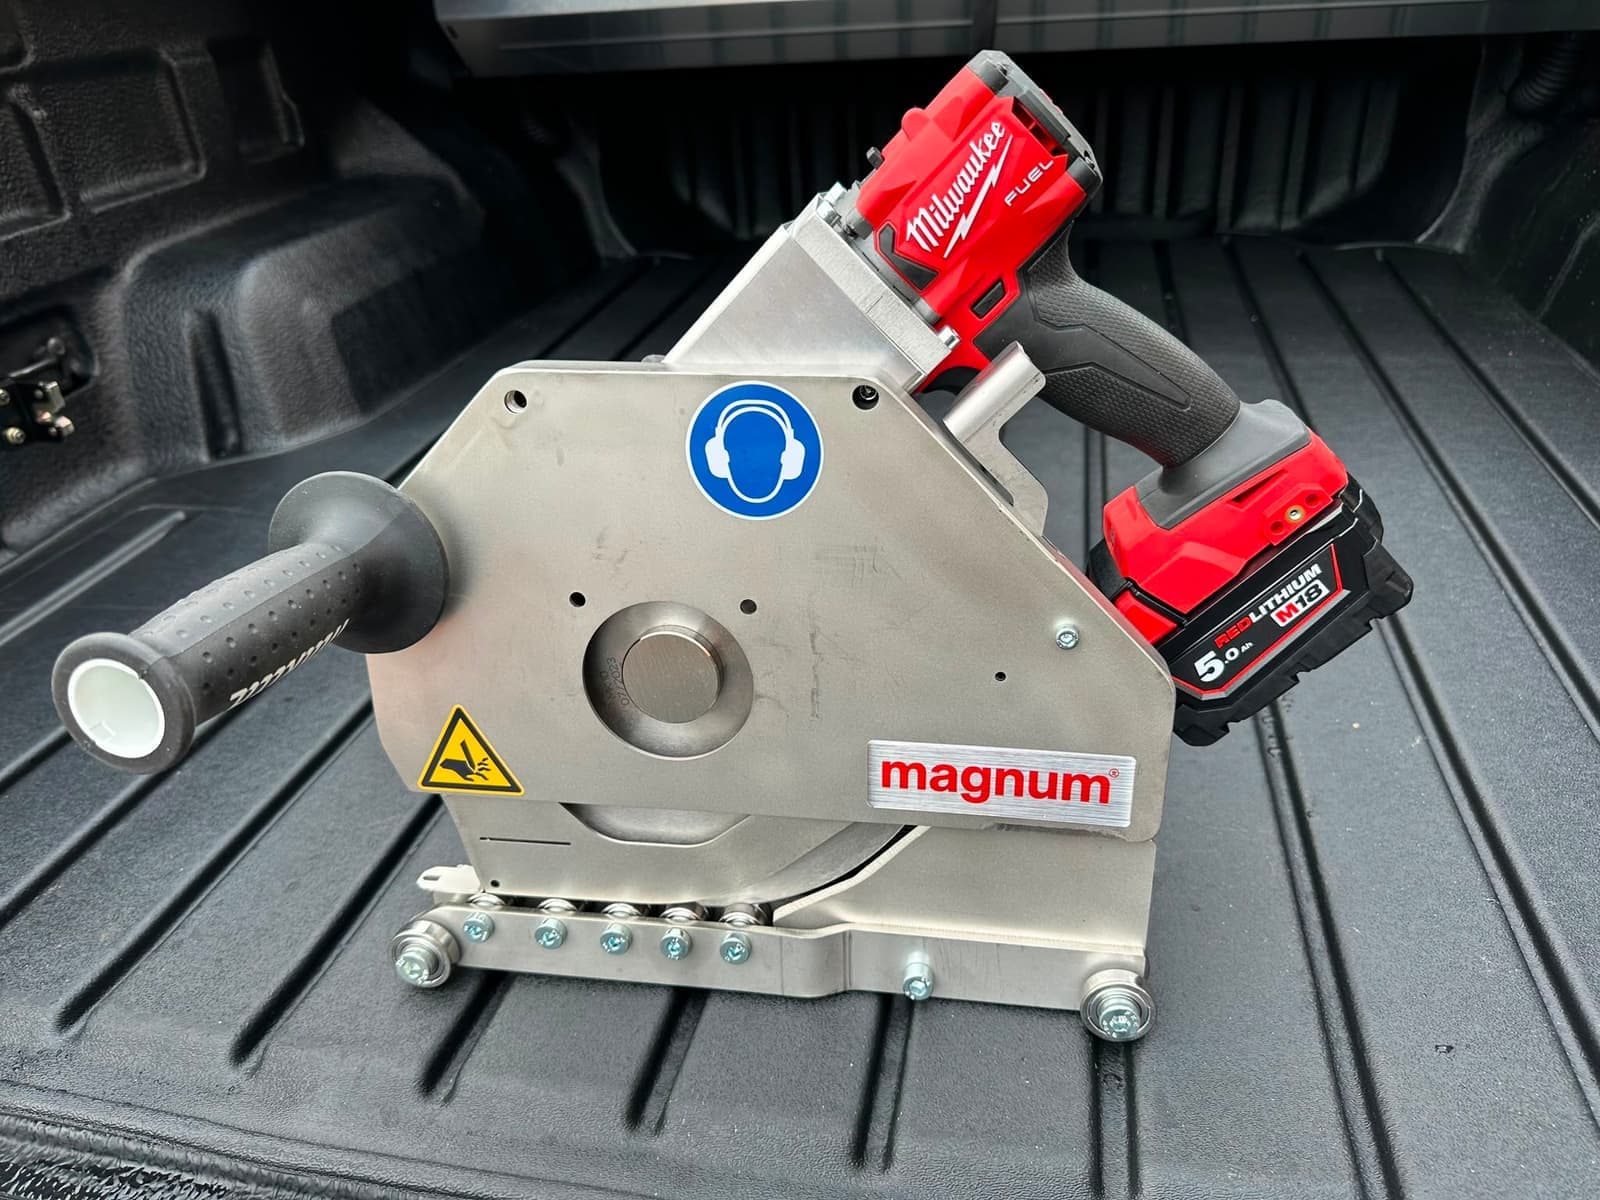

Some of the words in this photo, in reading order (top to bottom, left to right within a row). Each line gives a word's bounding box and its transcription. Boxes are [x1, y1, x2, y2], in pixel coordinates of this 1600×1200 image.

[905, 121, 1006, 253] Milwaukee
[1004, 160, 1055, 207] FUEL
[1214, 563, 1323, 649] REDLITHIUM
[1274, 583, 1324, 624] M18
[1194, 647, 1240, 682] 5.0
